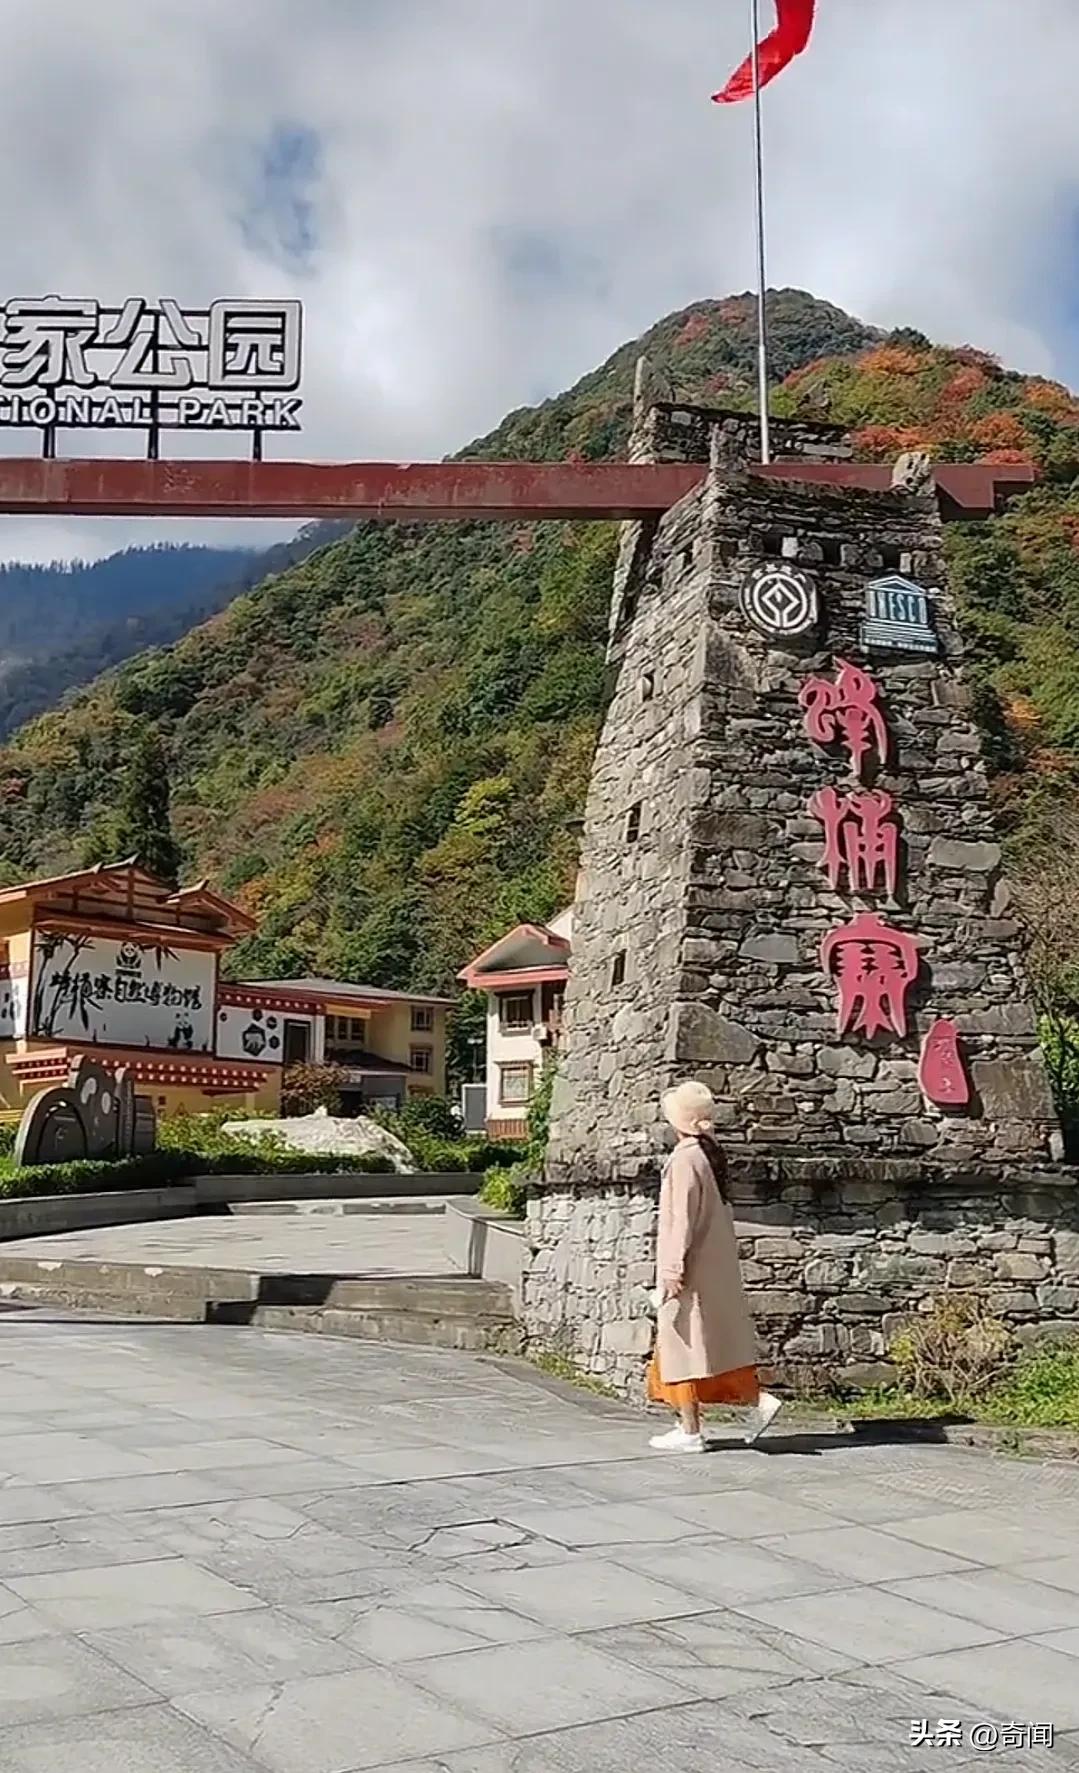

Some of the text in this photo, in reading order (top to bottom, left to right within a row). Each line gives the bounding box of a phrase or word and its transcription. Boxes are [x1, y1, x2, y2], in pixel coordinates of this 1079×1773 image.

[2, 295, 302, 389] 家公园
[0, 395, 302, 428] IONAL PARK
